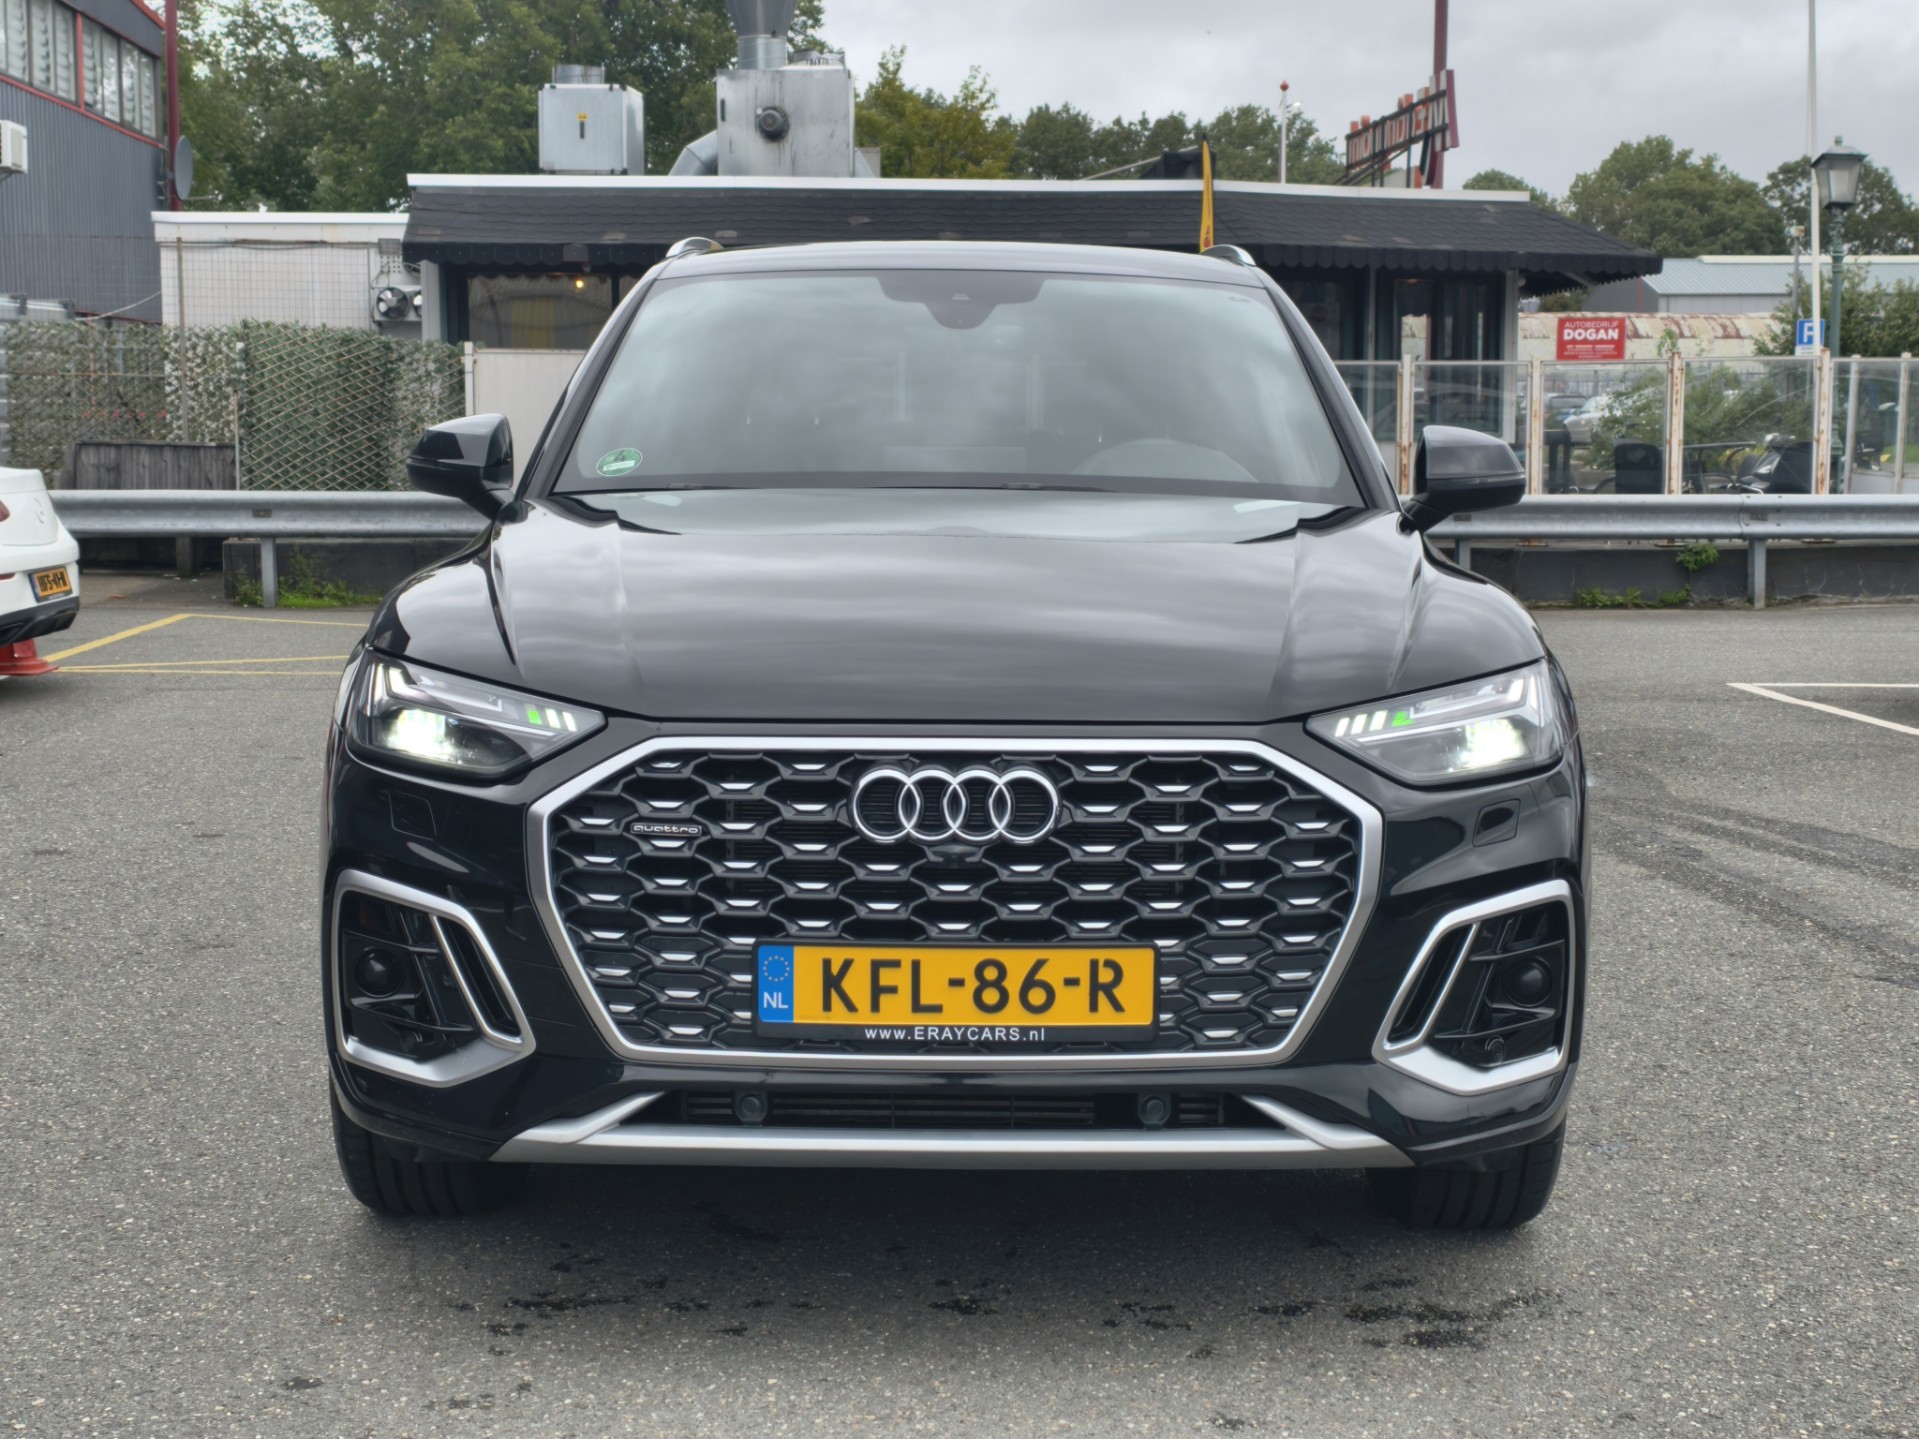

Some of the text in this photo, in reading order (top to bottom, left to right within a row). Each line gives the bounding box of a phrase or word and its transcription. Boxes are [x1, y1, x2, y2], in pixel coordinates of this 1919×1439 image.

[1563, 328, 1619, 340] DOGAN
[633, 825, 699, 834] quattro
[821, 957, 1125, 1014] KFL-86-R
[763, 991, 789, 1009] NL
[865, 1026, 1045, 1041] www.ERAYCARS.nl
